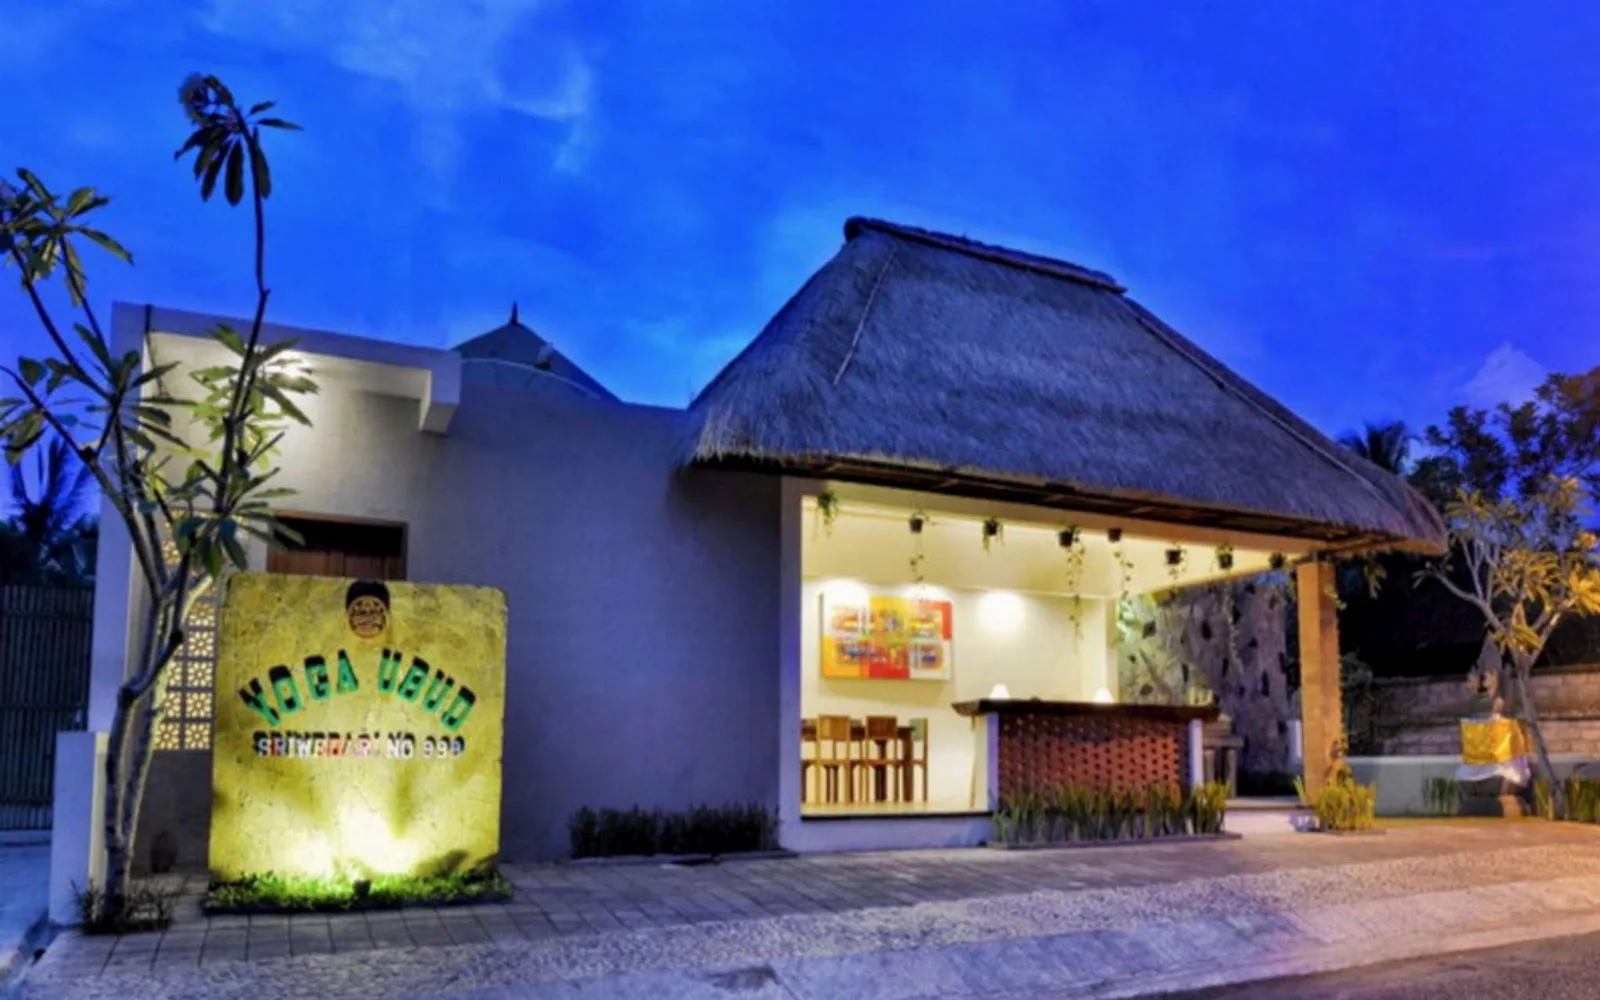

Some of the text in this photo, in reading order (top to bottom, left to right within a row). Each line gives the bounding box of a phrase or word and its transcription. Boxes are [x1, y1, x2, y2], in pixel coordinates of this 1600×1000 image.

[238, 647, 477, 731] YOGA UBUD
[387, 731, 416, 759] NO
